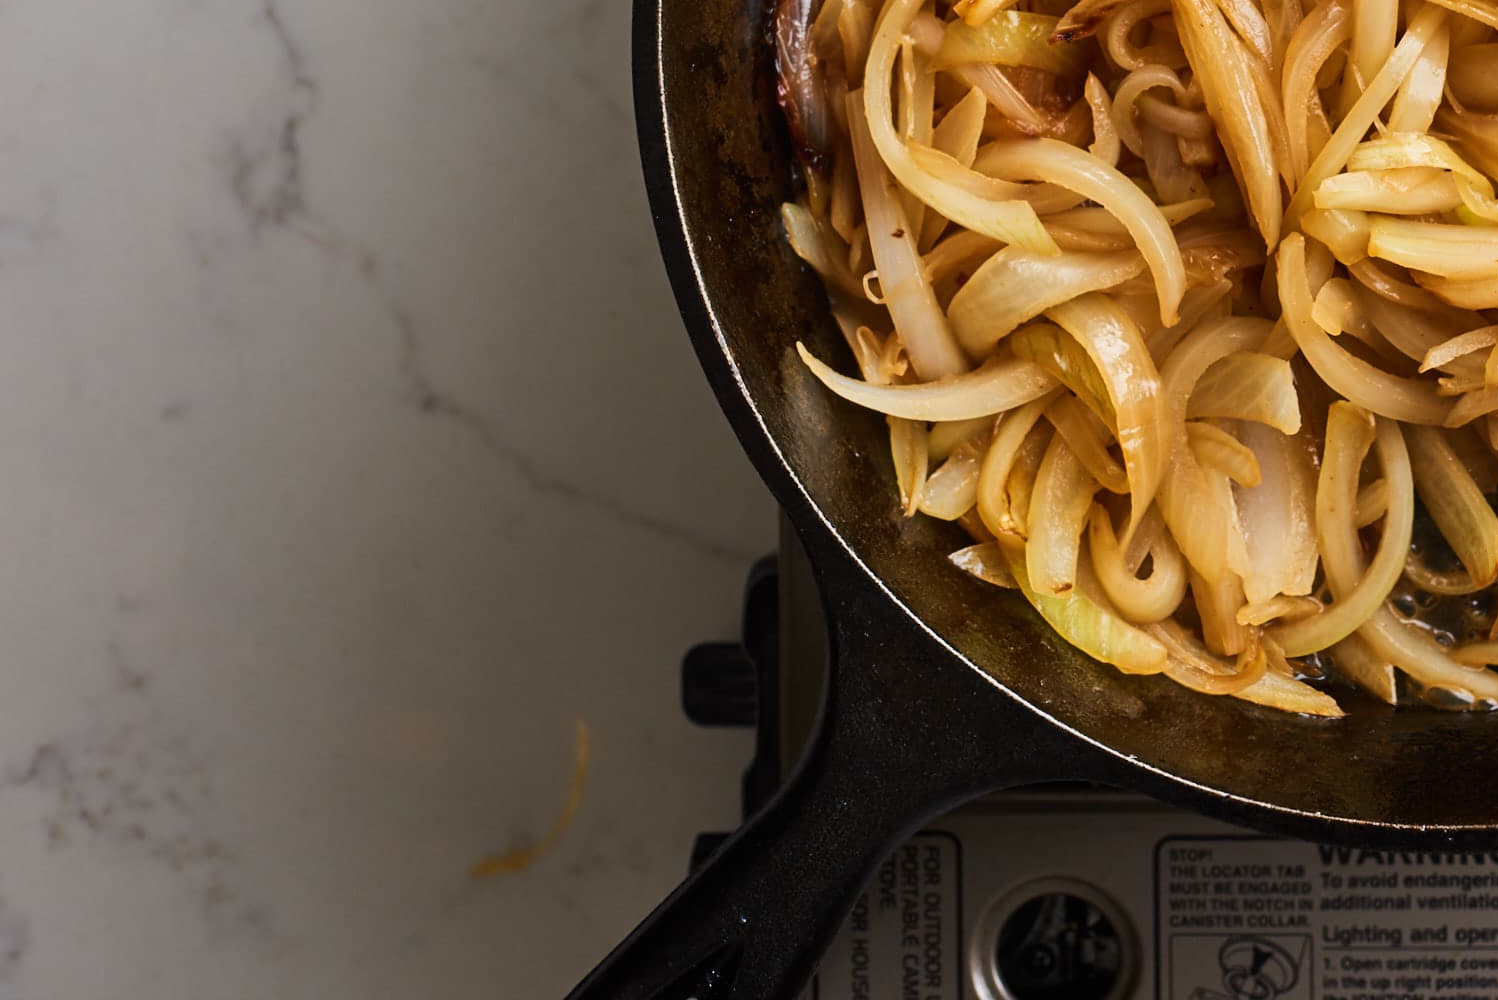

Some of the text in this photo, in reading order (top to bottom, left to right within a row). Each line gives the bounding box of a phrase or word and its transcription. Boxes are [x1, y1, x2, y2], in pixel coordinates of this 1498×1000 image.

[1169, 848, 1213, 862] STOP!
[924, 845, 941, 885] FOR
[1169, 865, 1305, 878] THE LOCATOR TAB
[1169, 882, 1312, 894] MUST BE ENGAGED
[1320, 872, 1342, 888] To
[1348, 872, 1398, 888] avoid
[901, 845, 920, 946] PORTABLE
[1320, 894, 1411, 910] additional
[1169, 899, 1314, 911] WITH THE NOTCH IN
[1169, 915, 1311, 927] CANISTER COLLAR.
[924, 892, 943, 987] OUTDOOR
[1322, 925, 1402, 946] Lighting
[1410, 925, 1448, 943] and
[1341, 957, 1382, 972] Open
[1386, 956, 1456, 972] cartridge
[1322, 976, 1338, 988] in
[1341, 975, 1366, 988] the
[1370, 977, 1391, 989] up
[1395, 975, 1432, 990] right
